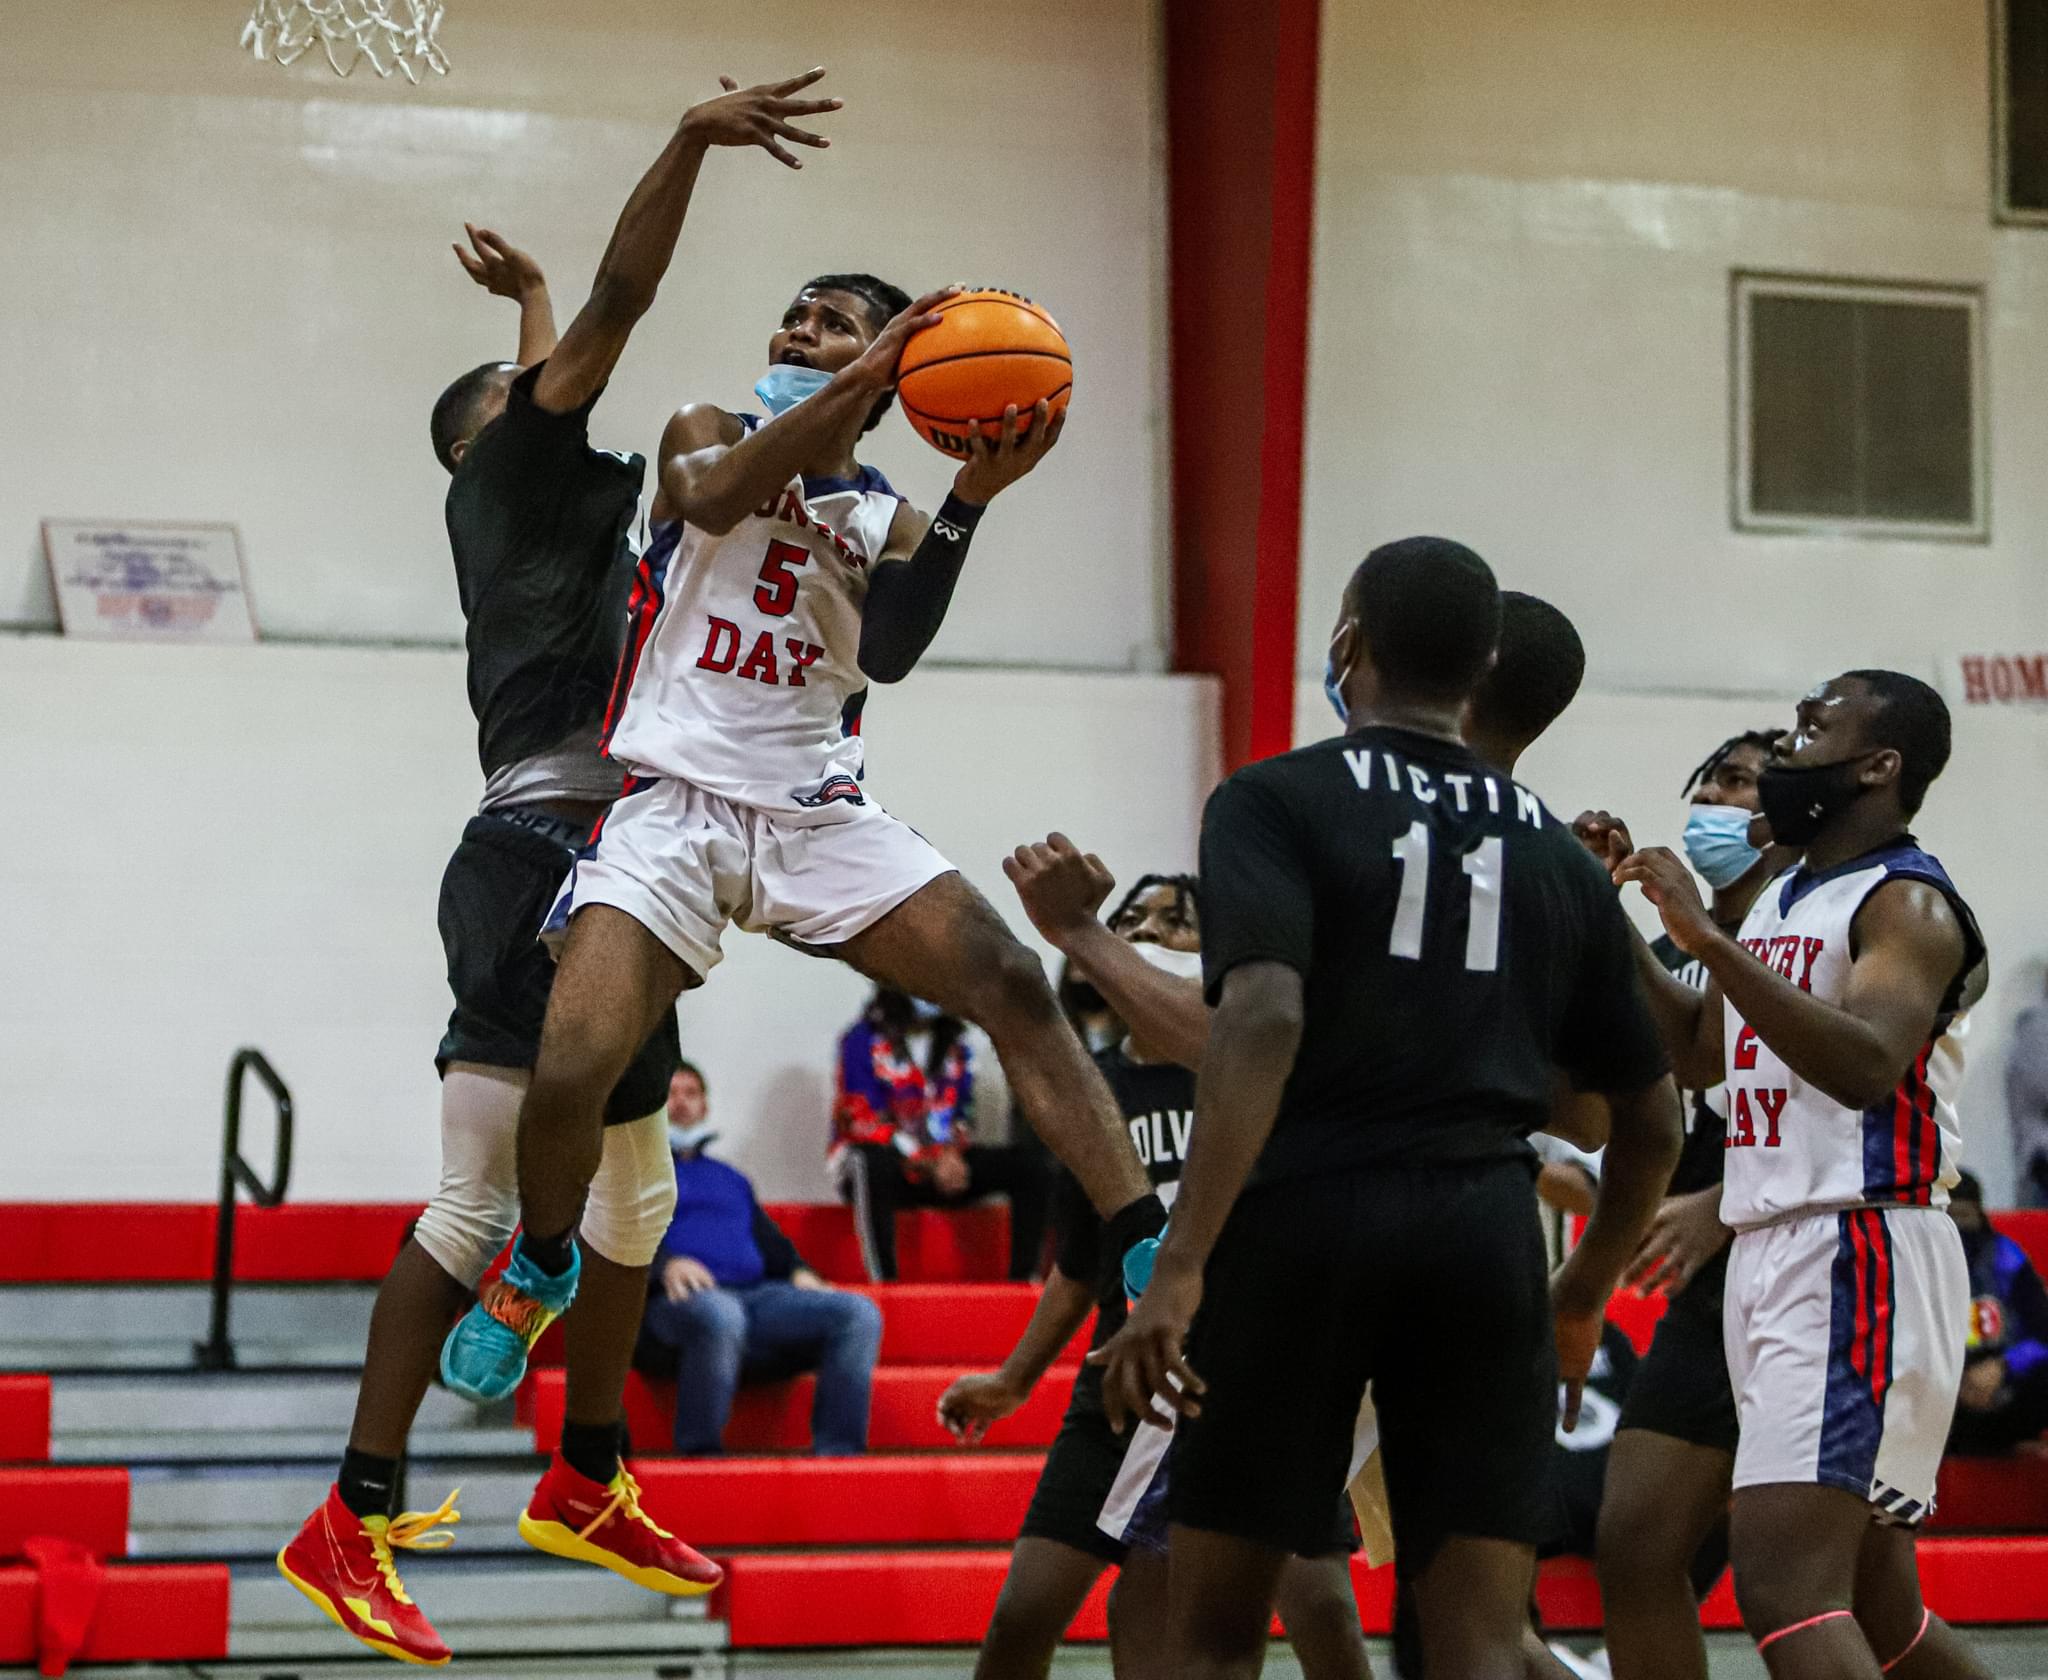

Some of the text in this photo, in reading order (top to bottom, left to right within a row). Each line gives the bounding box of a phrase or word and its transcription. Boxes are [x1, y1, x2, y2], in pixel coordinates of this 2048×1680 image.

[753, 538, 811, 617] 5
[697, 615, 825, 687] DAY
[1342, 750, 1543, 830] VICTIM
[1389, 821, 1503, 972] 11
[1724, 1087, 1788, 1149] AY
